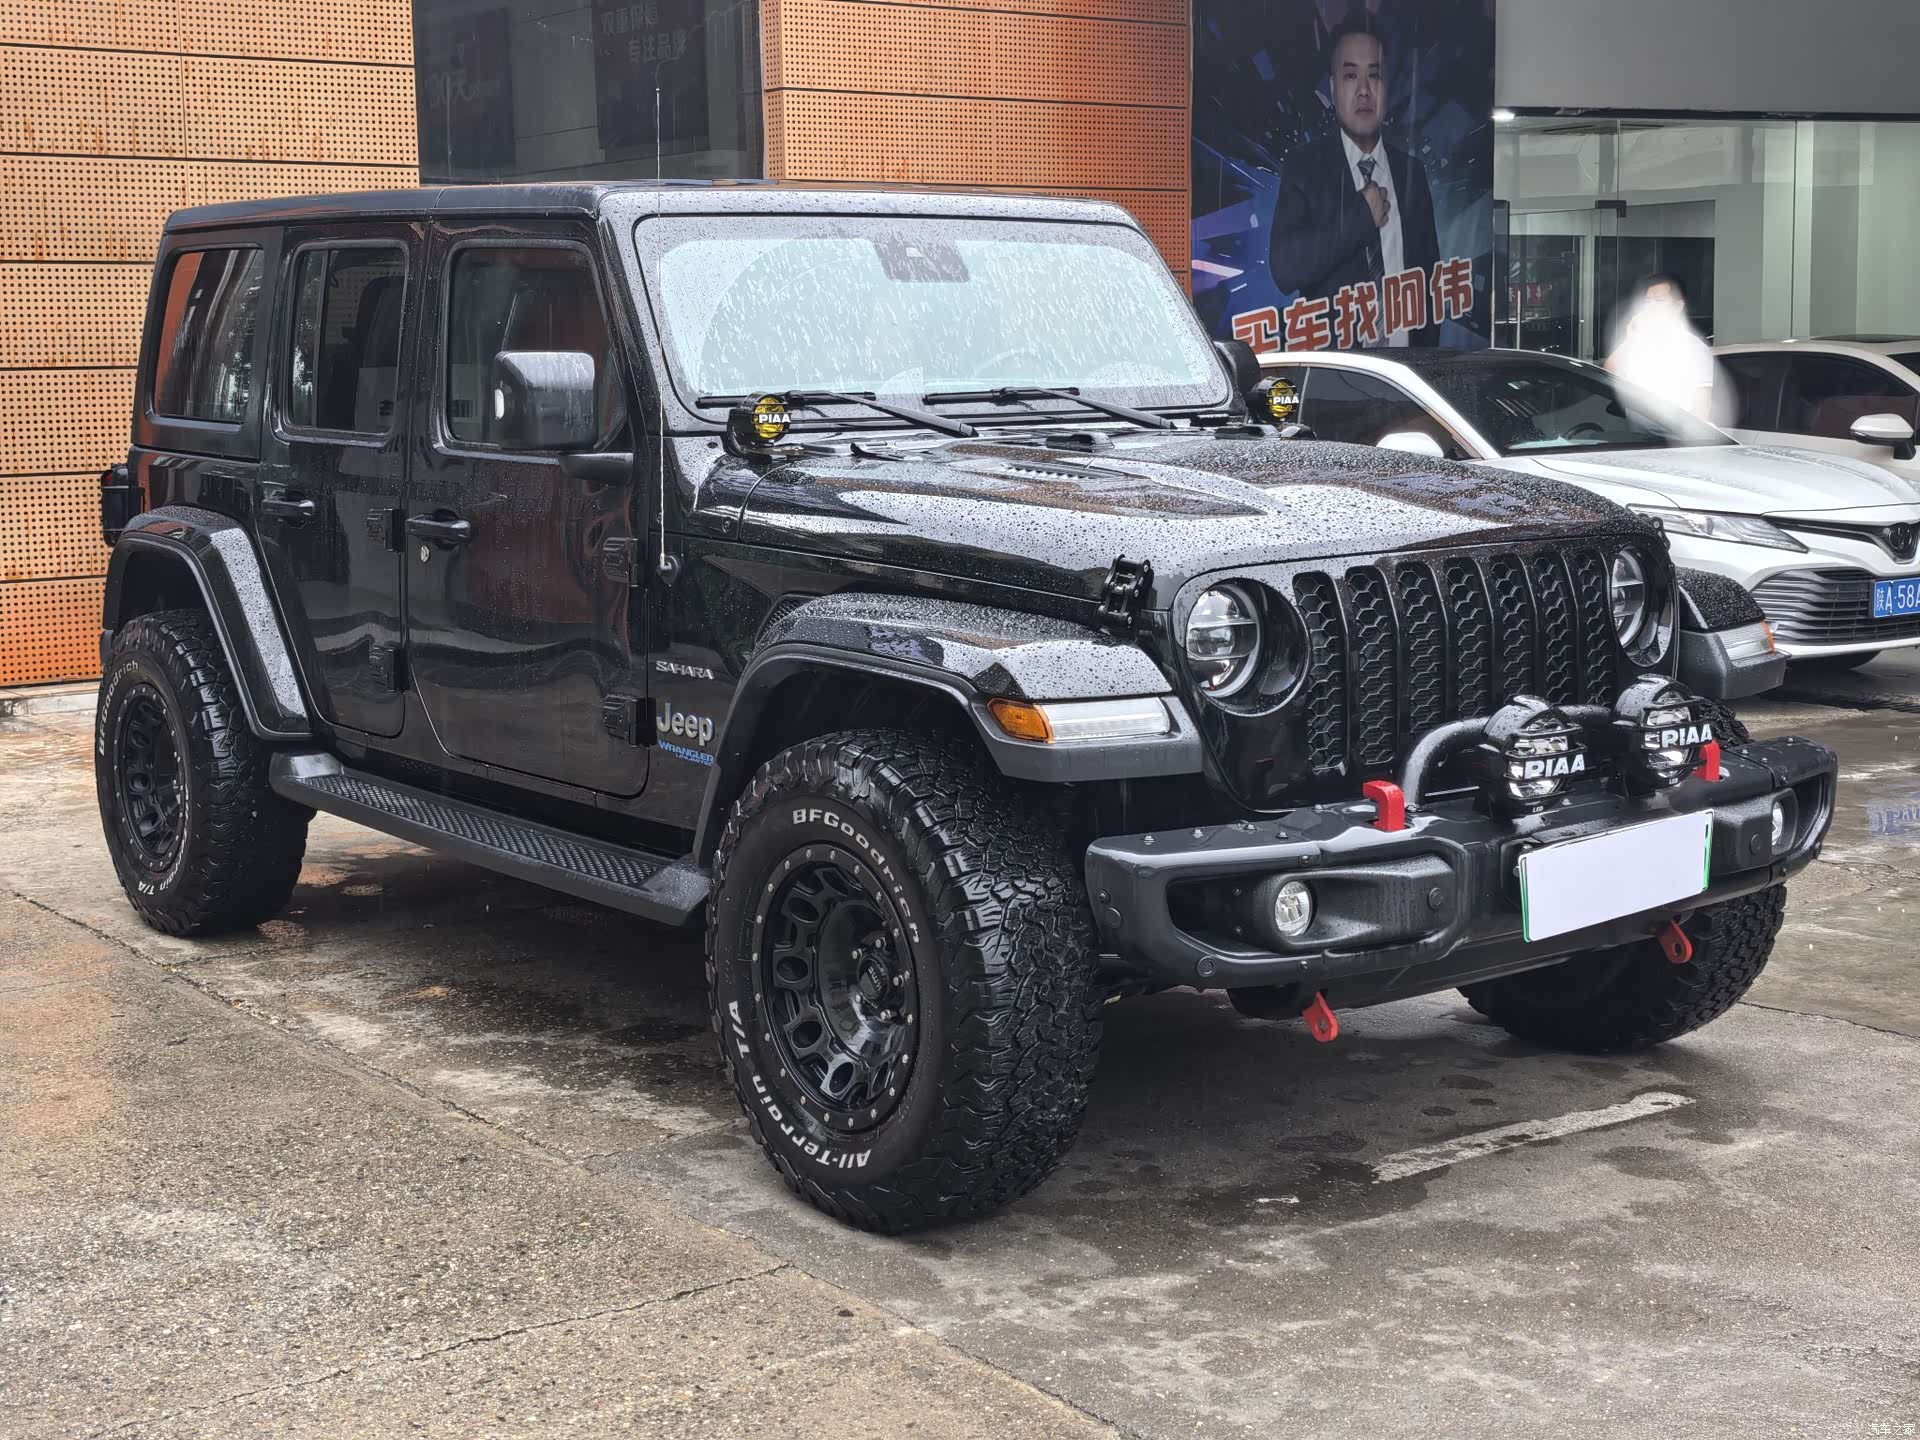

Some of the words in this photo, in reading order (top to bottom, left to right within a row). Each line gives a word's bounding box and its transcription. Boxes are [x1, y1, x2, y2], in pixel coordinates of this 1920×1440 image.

[1232, 256, 1473, 354] 买车找阿伟
[1273, 395, 1299, 405] PIAA
[758, 413, 791, 423] PIAA
[656, 660, 714, 680] SAHARA
[98, 660, 139, 756] BFGoodrich
[656, 702, 714, 747] Jeep
[1661, 723, 1713, 748] PIAA
[658, 739, 713, 762] WRANGLER
[1524, 753, 1586, 779] PIAA
[138, 881, 155, 895] T/A
[792, 808, 920, 943] BFGoodrich
[728, 1000, 750, 1059] T/A
[752, 1075, 872, 1169] All-Terrain
